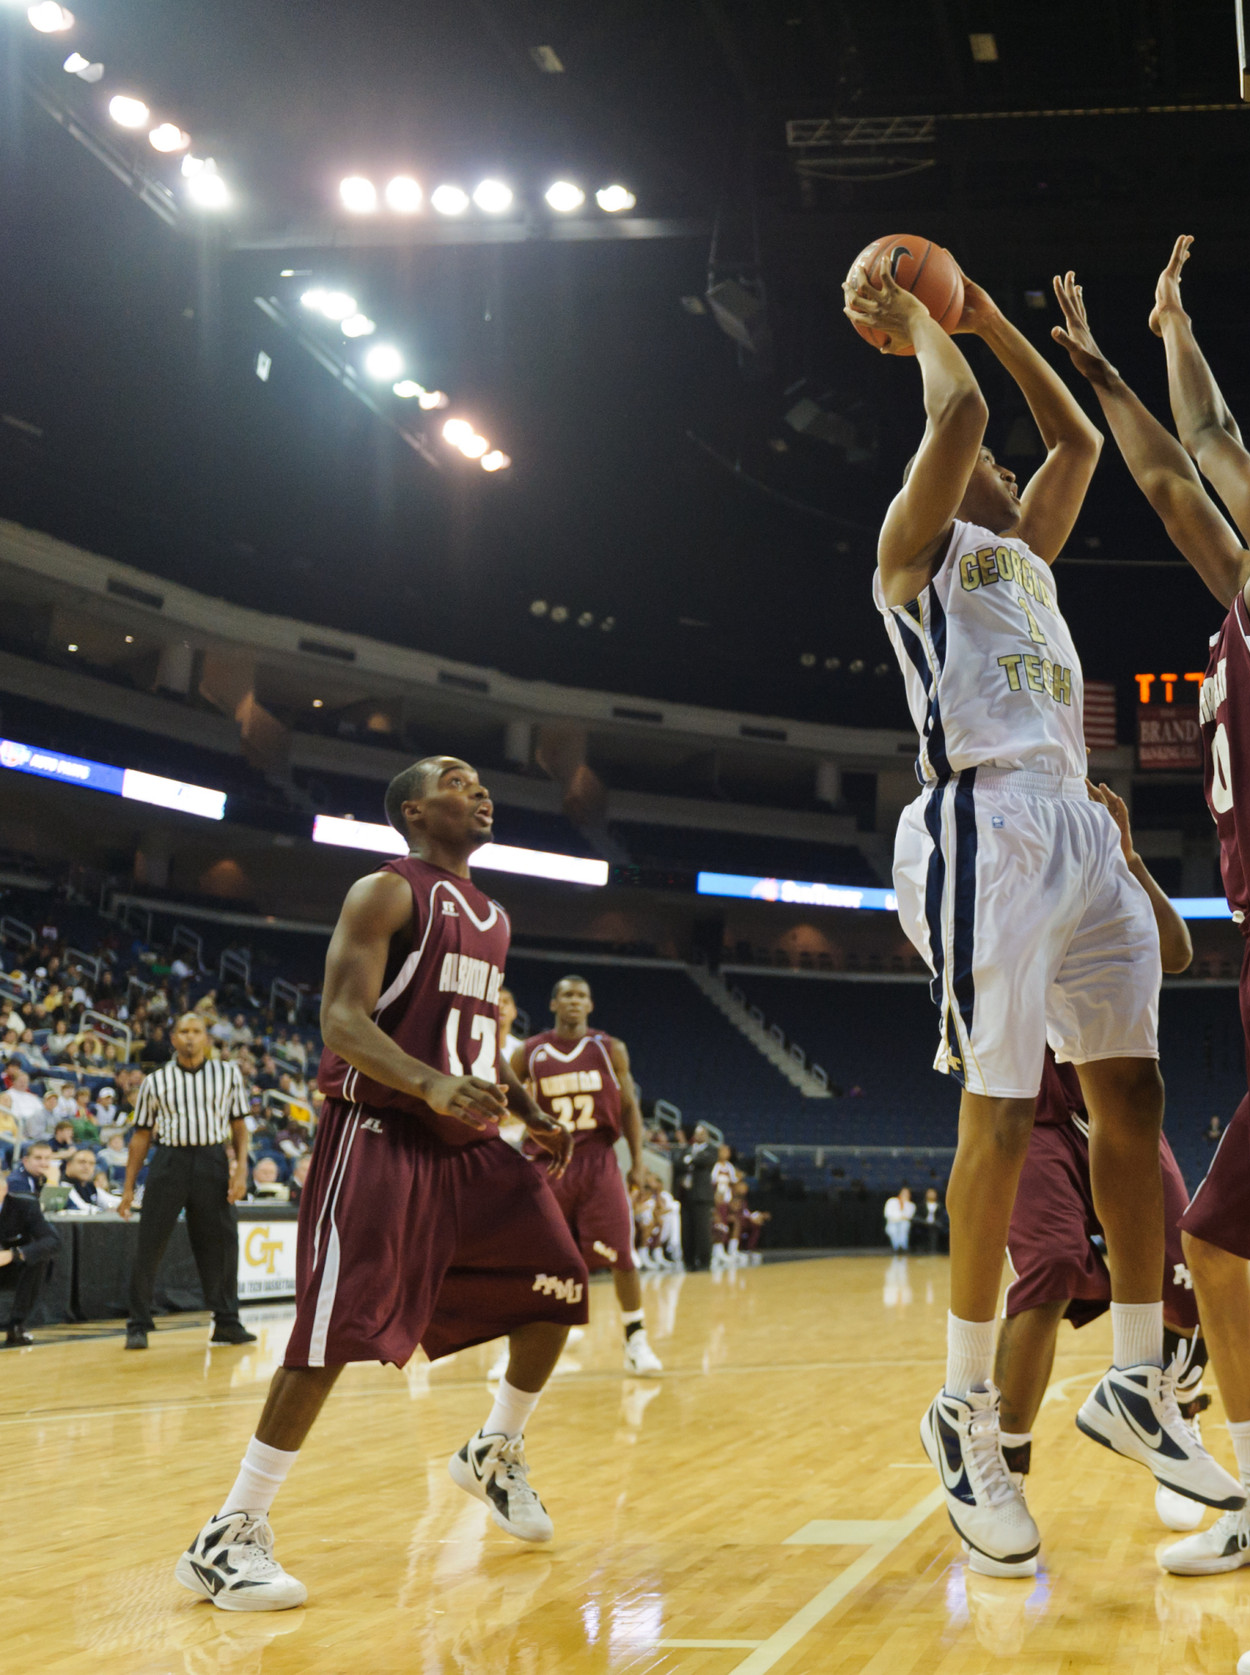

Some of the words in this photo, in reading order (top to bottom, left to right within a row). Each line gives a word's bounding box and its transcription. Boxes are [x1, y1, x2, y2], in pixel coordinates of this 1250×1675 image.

[959, 545, 1057, 617] GEORGIA
[1018, 597, 1047, 645] 1
[997, 654, 1072, 706] TECH
[1140, 720, 1200, 742] BRAND
[551, 1095, 597, 1133] 22
[244, 1226, 284, 1275] GT
